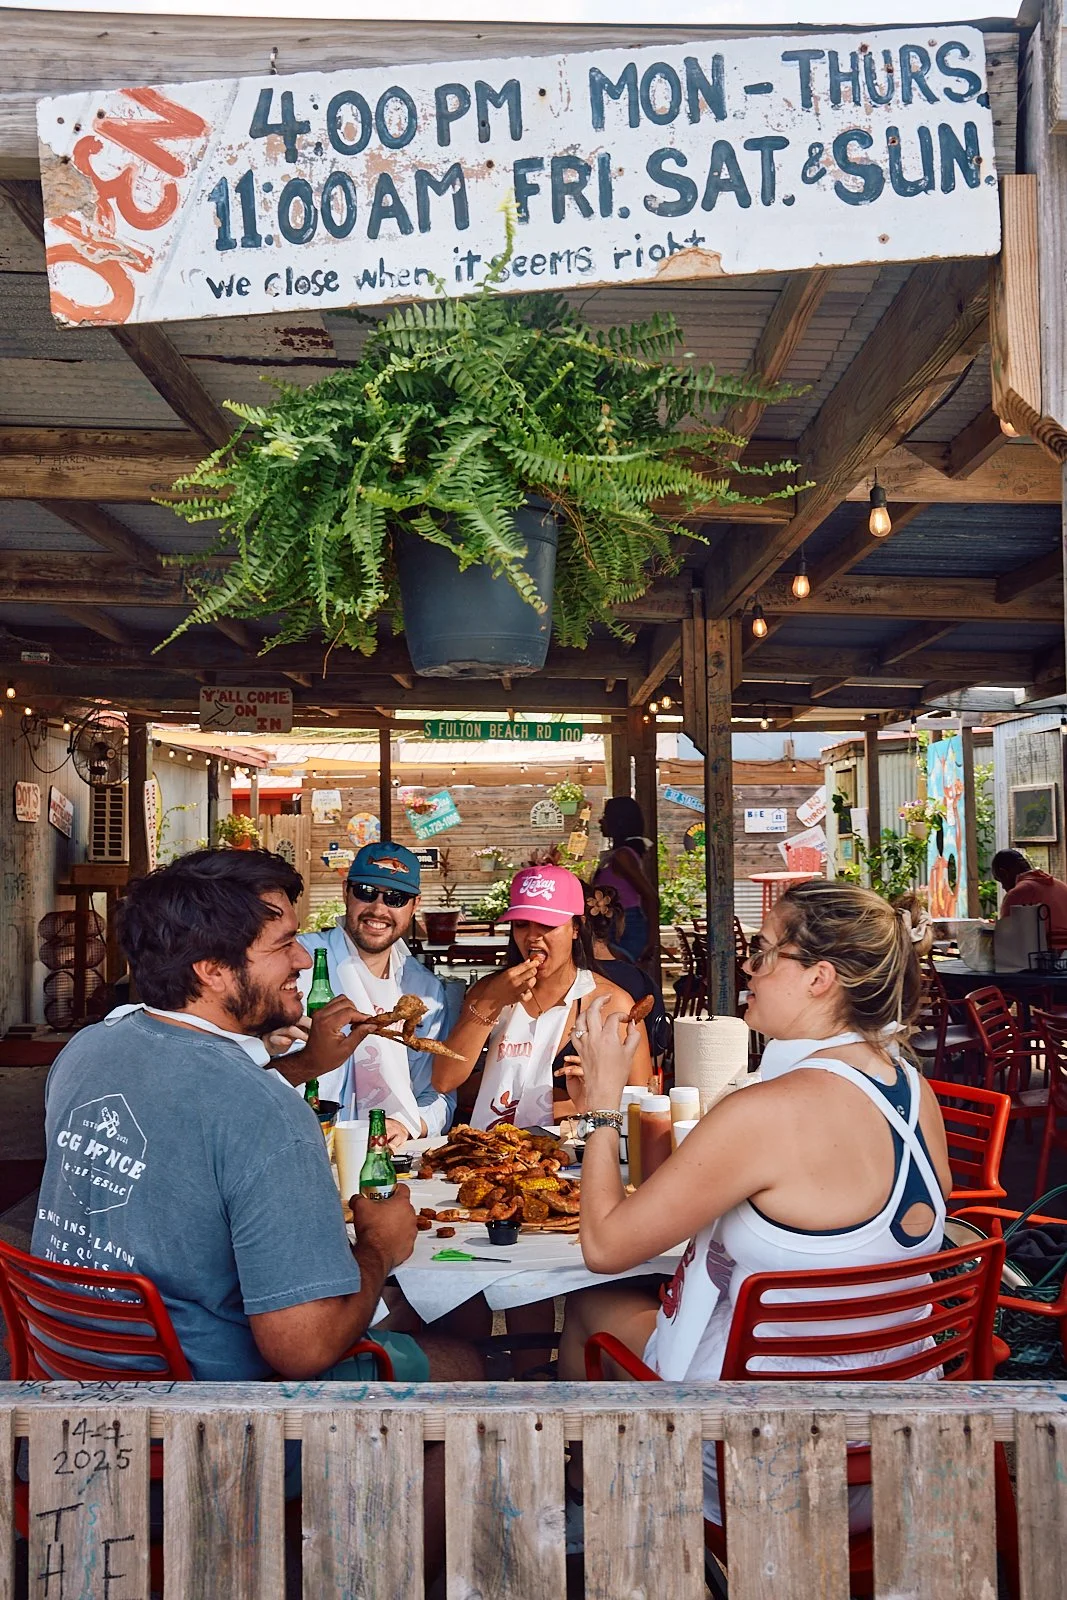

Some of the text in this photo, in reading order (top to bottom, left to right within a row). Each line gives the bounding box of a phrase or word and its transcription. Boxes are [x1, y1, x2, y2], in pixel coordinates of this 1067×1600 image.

[249, 86, 418, 163] 4:00
[435, 78, 523, 147] PM
[513, 152, 630, 226] FRI.
[644, 135, 796, 218] SAT.
[832, 120, 996, 207] SUN.
[205, 274, 251, 298] we
[265, 265, 340, 297] close
[355, 257, 434, 289] when
[453, 246, 482, 283] it
[202, 688, 290, 705] Y'ALL COME
[234, 704, 258, 717] ON
[256, 717, 282, 731] IN
[424, 722, 581, 741] S FULTON BEACH RD 100
[531, 802, 563, 825] RANCH WATER
[806, 795, 821, 810] NO
[57, 1130, 82, 1152] CG
[53, 1449, 133, 1475] 2025
